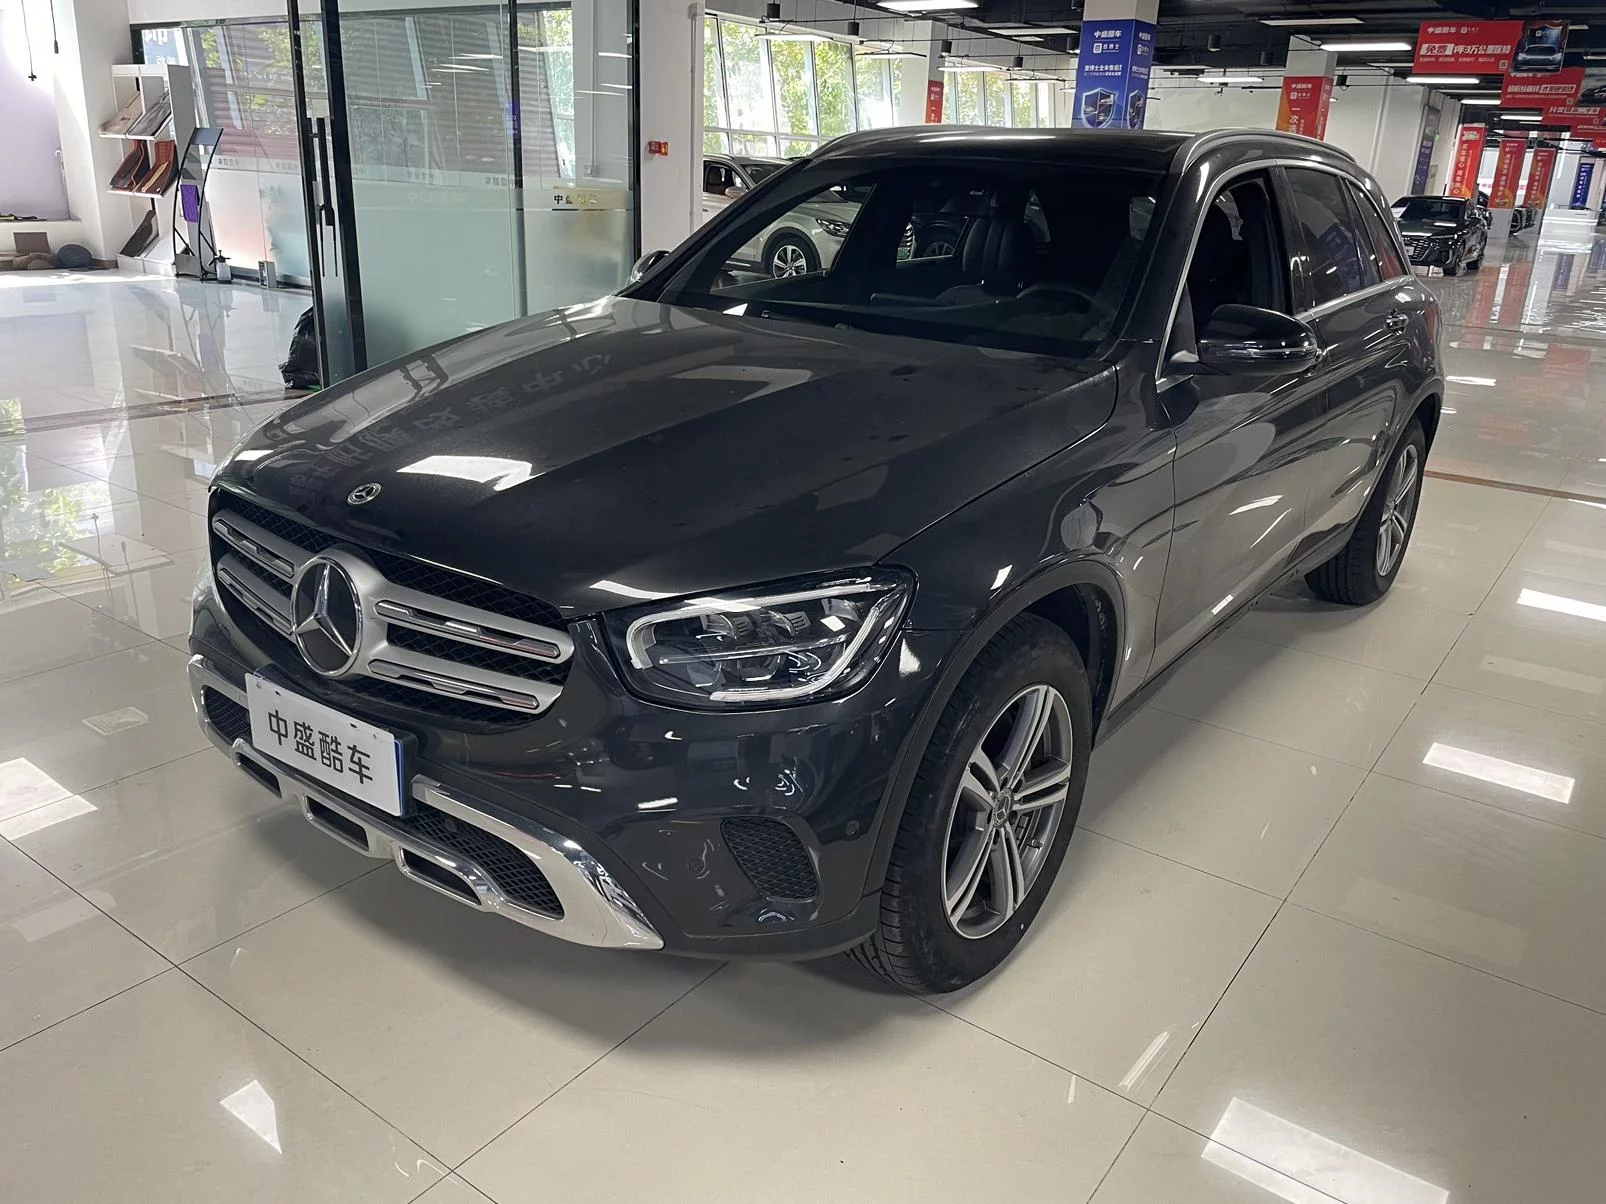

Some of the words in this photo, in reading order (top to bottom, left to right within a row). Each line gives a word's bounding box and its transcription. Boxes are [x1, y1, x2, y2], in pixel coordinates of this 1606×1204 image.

[1094, 30, 1122, 38] 中盛酷车
[268, 709, 374, 785] 中盛酷车
